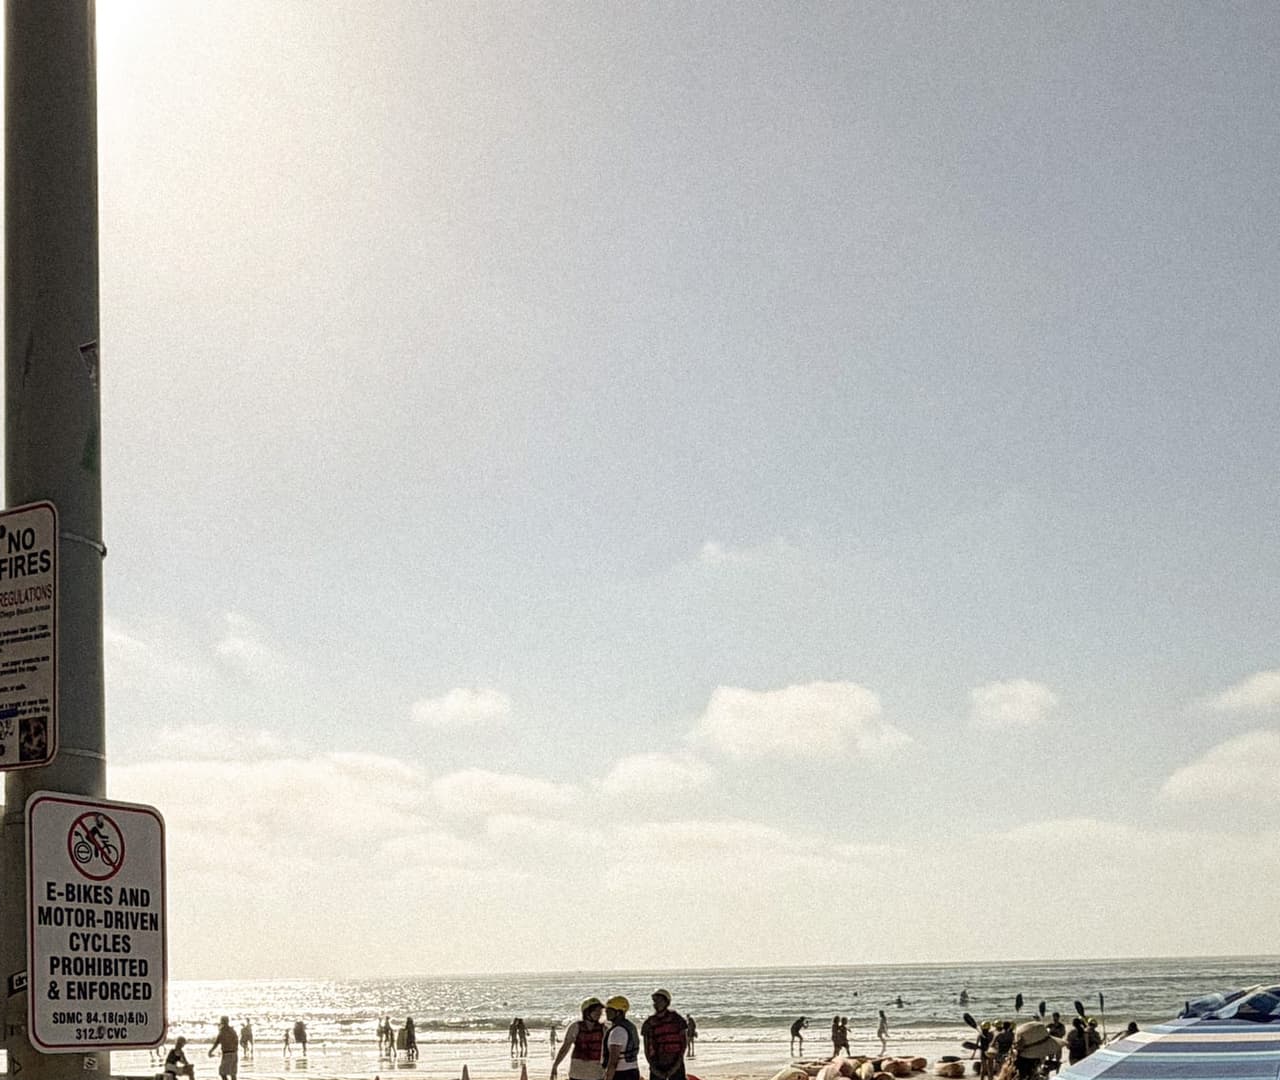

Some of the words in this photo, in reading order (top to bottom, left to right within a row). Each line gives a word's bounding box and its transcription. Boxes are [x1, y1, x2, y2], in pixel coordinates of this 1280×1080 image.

[7, 527, 35, 554] NO
[47, 881, 113, 905] E-BIKES
[118, 887, 150, 907] AND
[38, 906, 158, 931] MOTOR-DRIVEN
[69, 932, 131, 953] CYCLES
[49, 956, 148, 977] PROHIBITED
[47, 980, 60, 1000] &
[66, 981, 152, 1001] ENFORCED
[52, 1011, 82, 1025] SDMC
[86, 1012, 148, 1026] 84.18(a)&(b)
[107, 1027, 127, 1039] CVC
